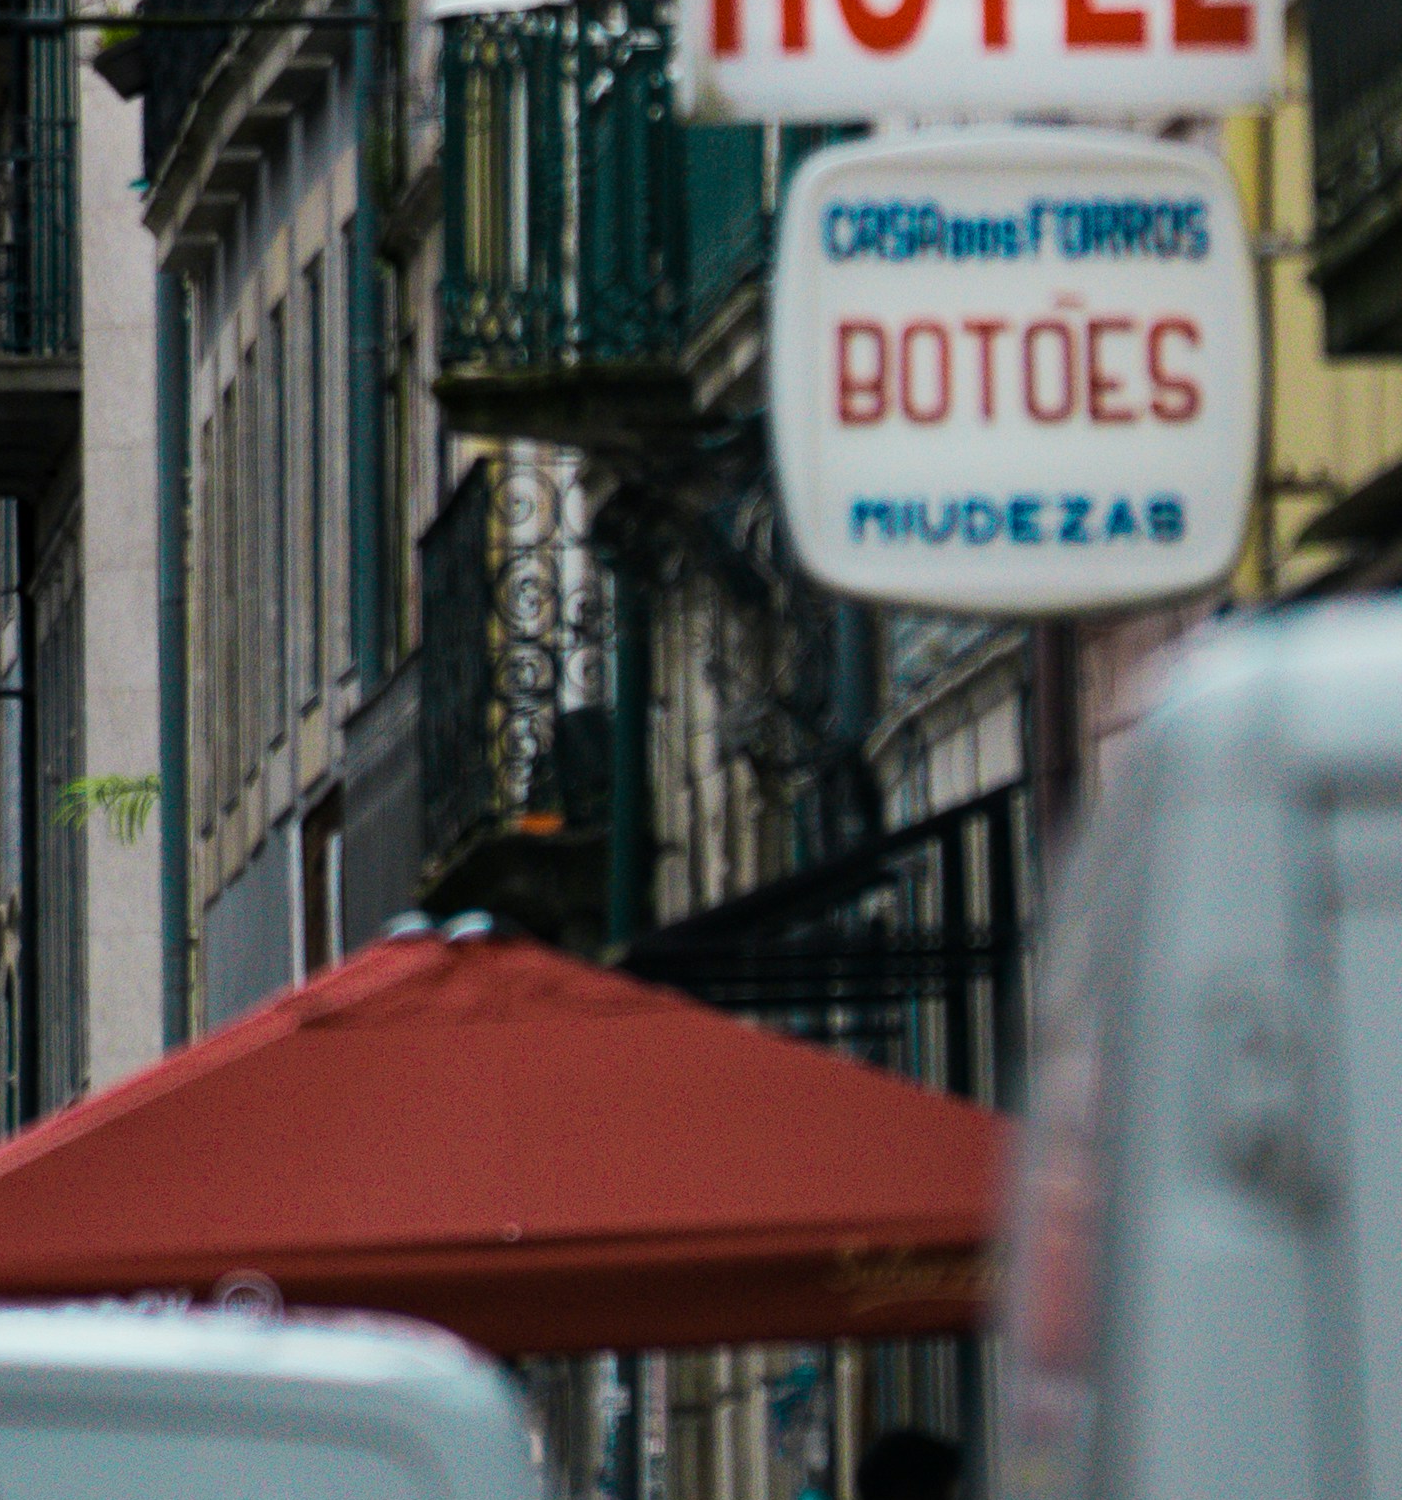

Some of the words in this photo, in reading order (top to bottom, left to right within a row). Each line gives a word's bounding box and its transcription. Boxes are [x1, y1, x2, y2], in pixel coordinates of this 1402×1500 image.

[823, 202, 945, 262] CASA
[835, 290, 1205, 428] BOTÕES
[849, 494, 1186, 546] MIUDEZAS
